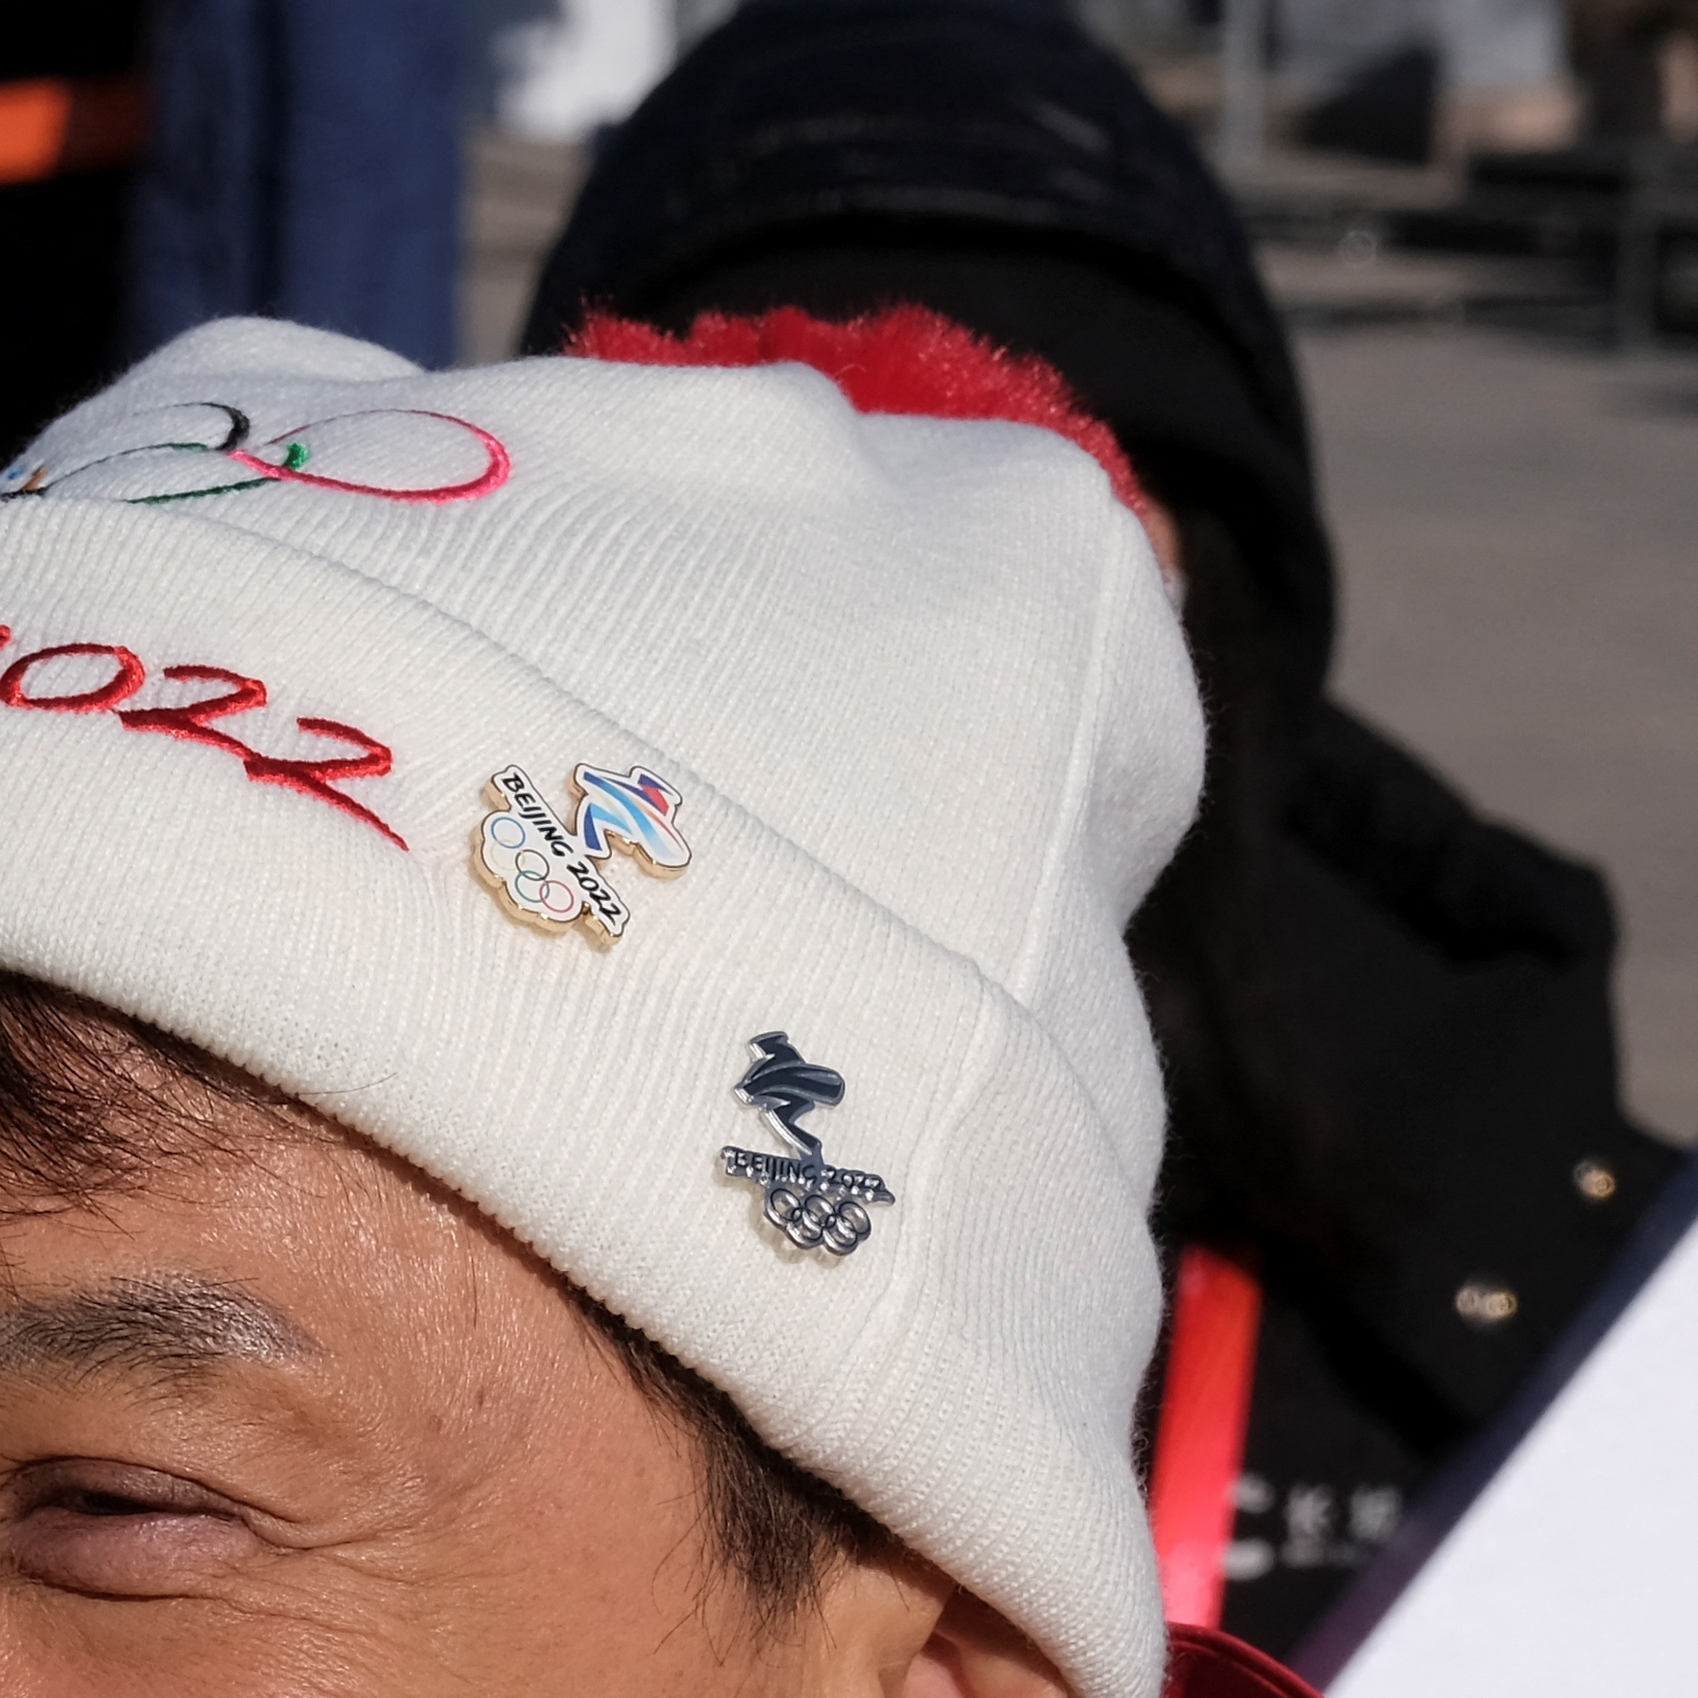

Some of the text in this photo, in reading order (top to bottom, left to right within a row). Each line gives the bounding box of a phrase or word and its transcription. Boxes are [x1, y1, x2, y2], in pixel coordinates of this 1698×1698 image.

[503, 772, 622, 926] BEIJING 2022
[733, 1150, 818, 1187] BEIJING
